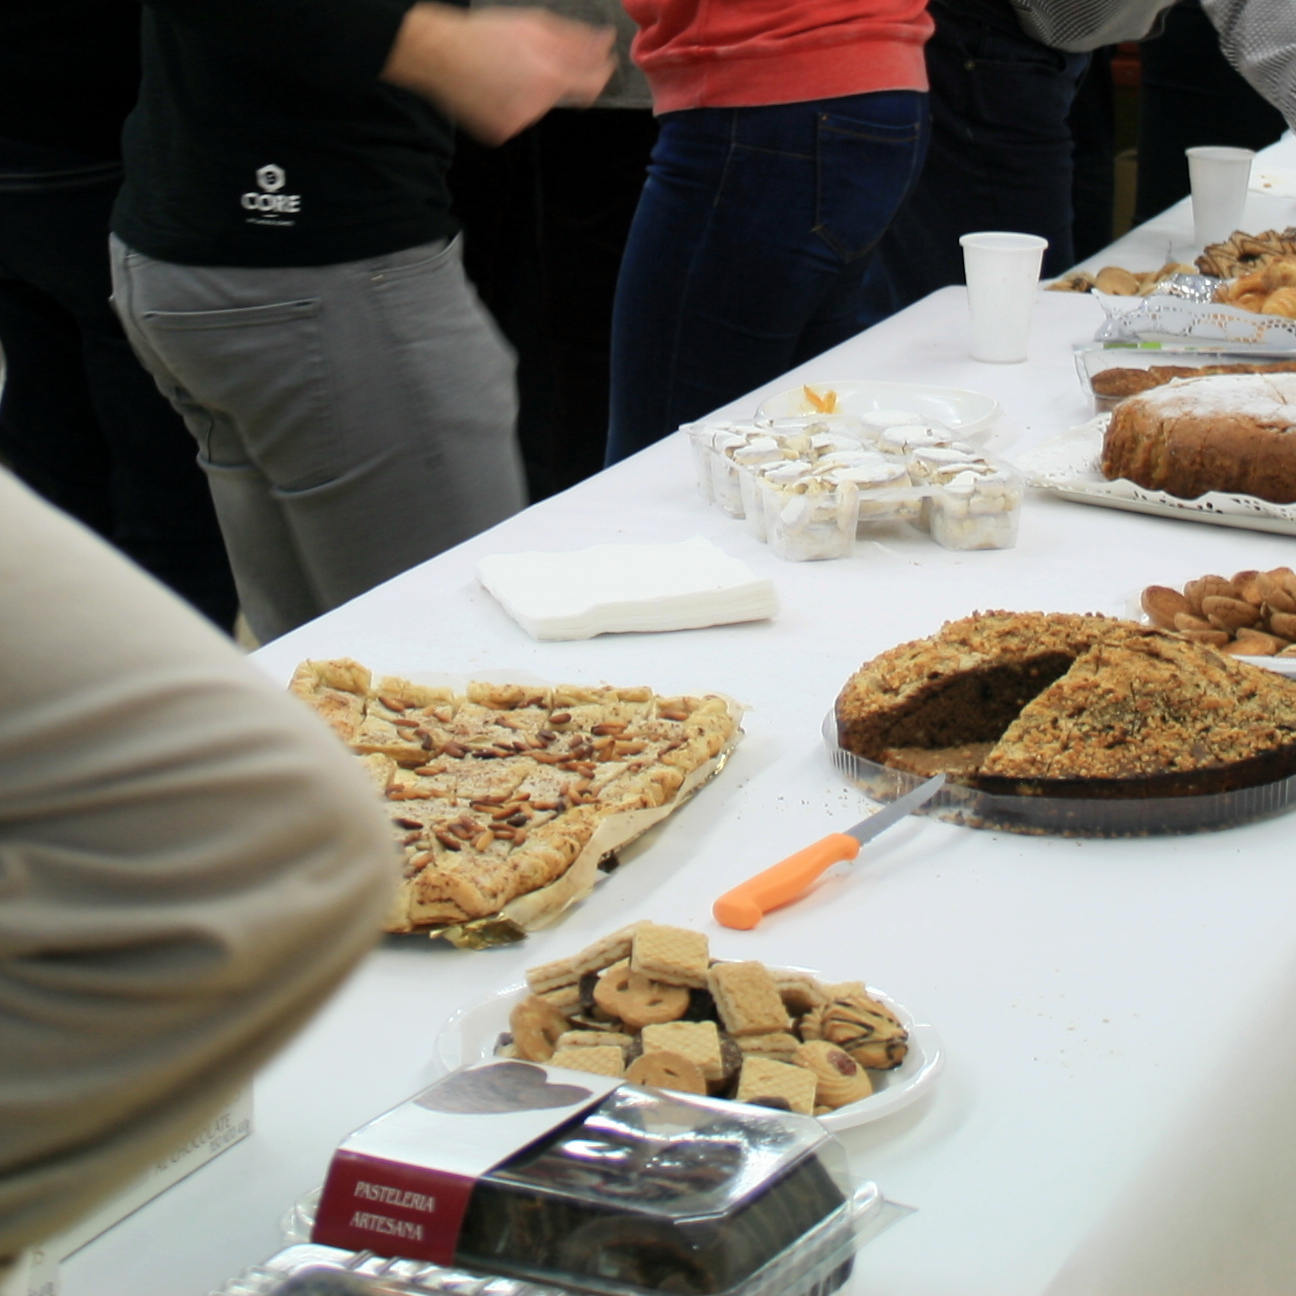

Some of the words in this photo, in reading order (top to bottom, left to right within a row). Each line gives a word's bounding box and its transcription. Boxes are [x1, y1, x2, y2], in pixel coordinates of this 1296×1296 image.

[240, 191, 302, 213] CORE
[353, 1180, 436, 1213] PASTELERIA
[349, 1210, 424, 1241] ARTESANA
